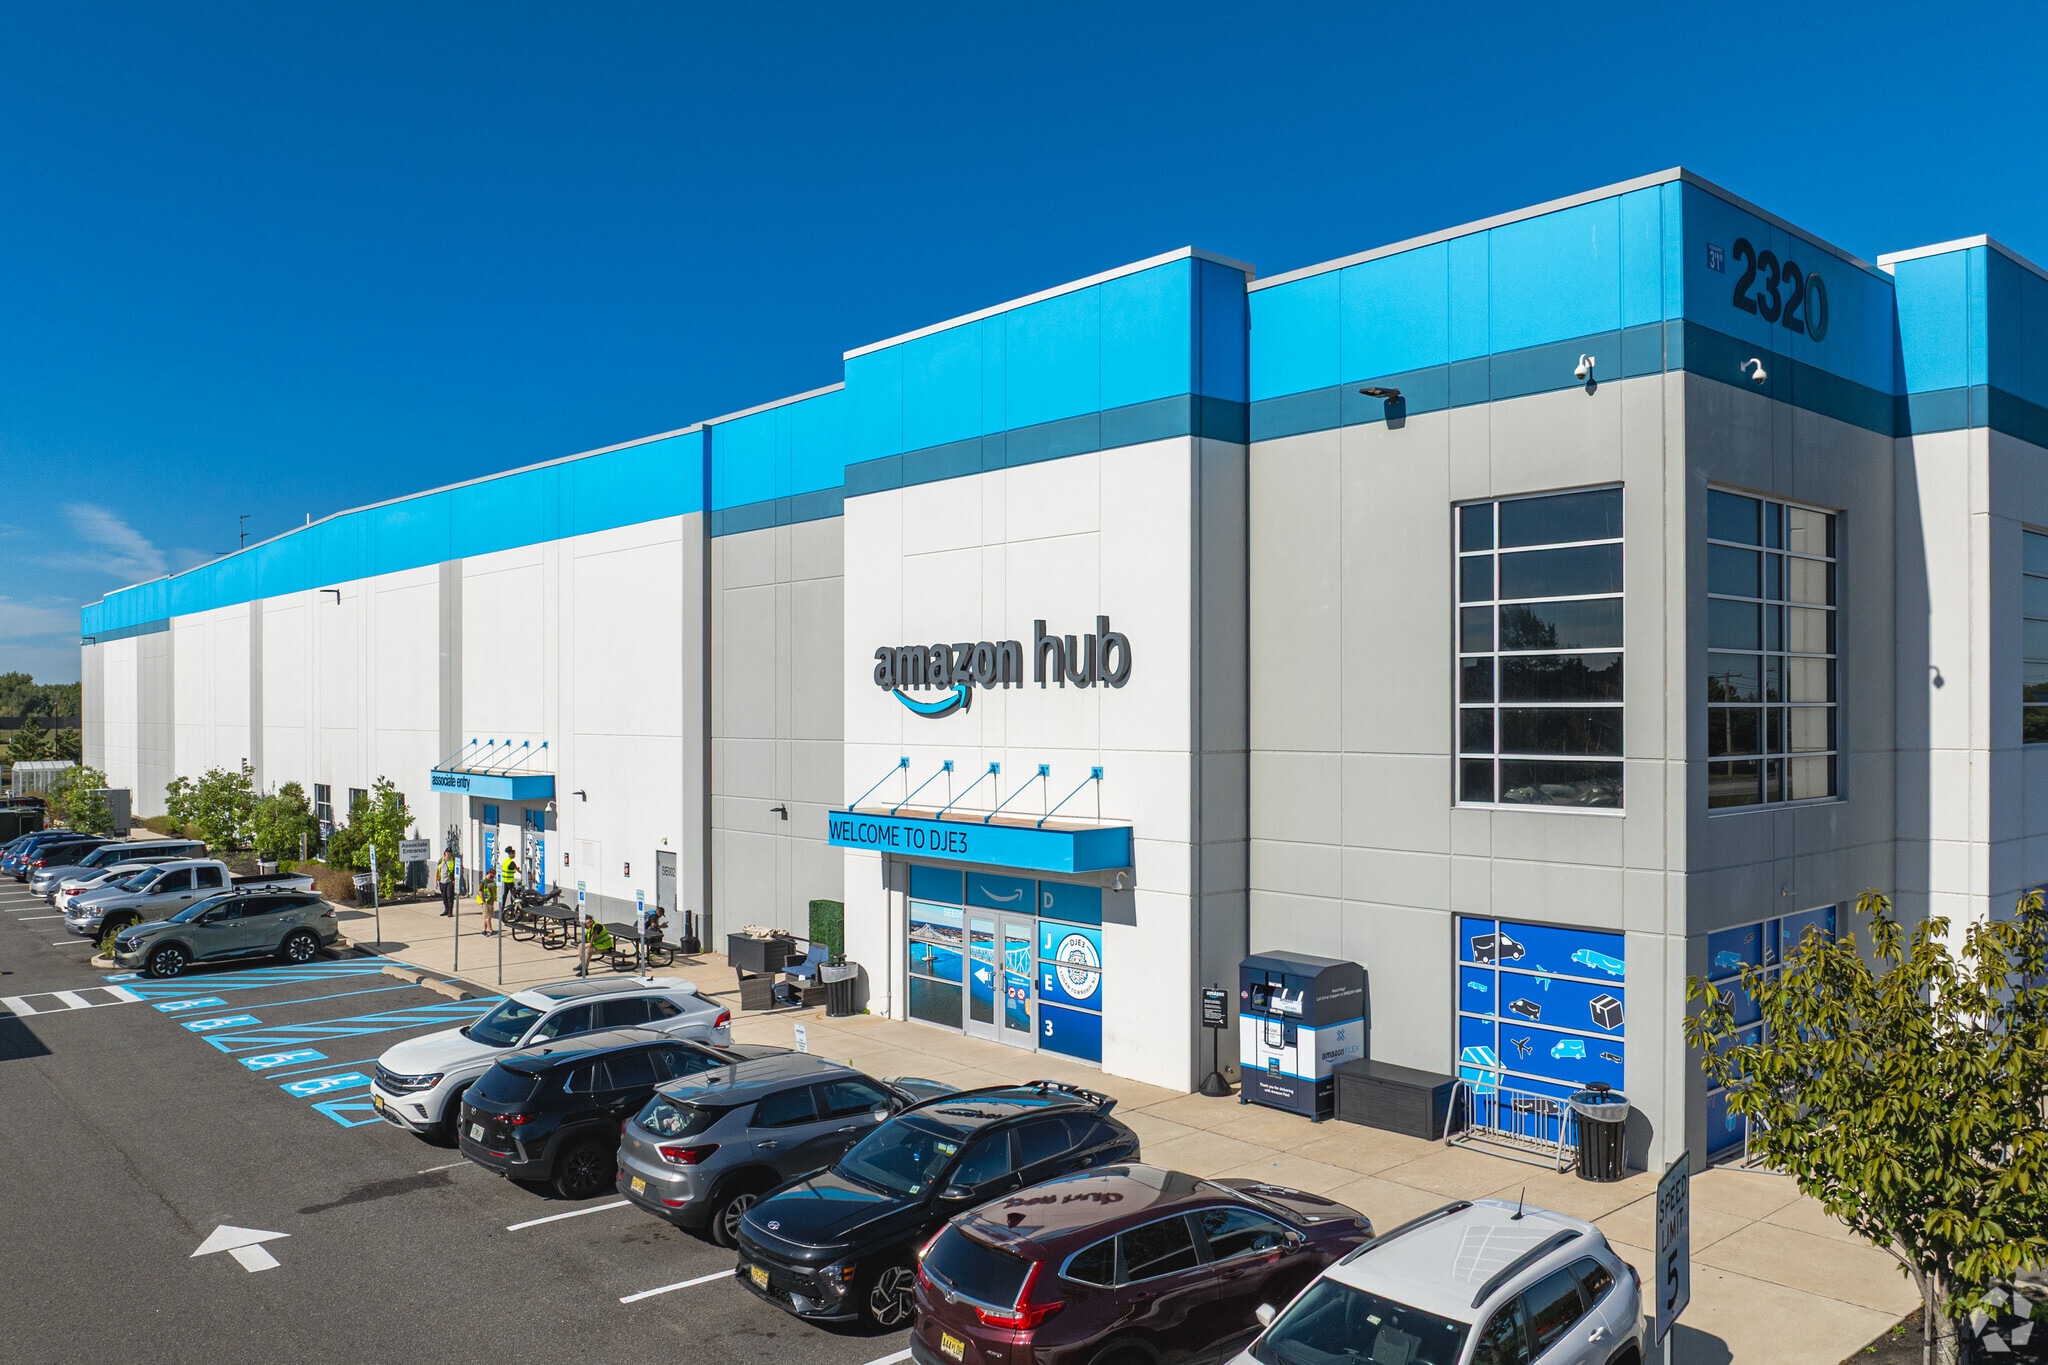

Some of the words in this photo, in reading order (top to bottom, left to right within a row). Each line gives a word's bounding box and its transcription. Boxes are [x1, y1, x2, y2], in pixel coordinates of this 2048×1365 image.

[1732, 237, 1829, 343] 2320
[873, 640, 1024, 691] amazon
[1034, 615, 1133, 690] hub
[432, 774, 456, 788] associate
[456, 775, 471, 792] entry
[829, 819, 900, 847] WELCOME
[904, 827, 925, 849] TO
[930, 829, 968, 854] DJE3
[1069, 938, 1086, 948] DJE3
[1321, 1048, 1345, 1060] amazon
[1345, 1044, 1360, 1054] FLEX
[1659, 1173, 1687, 1224] SPEED
[1661, 1206, 1684, 1253] LIMIT
[1667, 1248, 1679, 1310] 5
